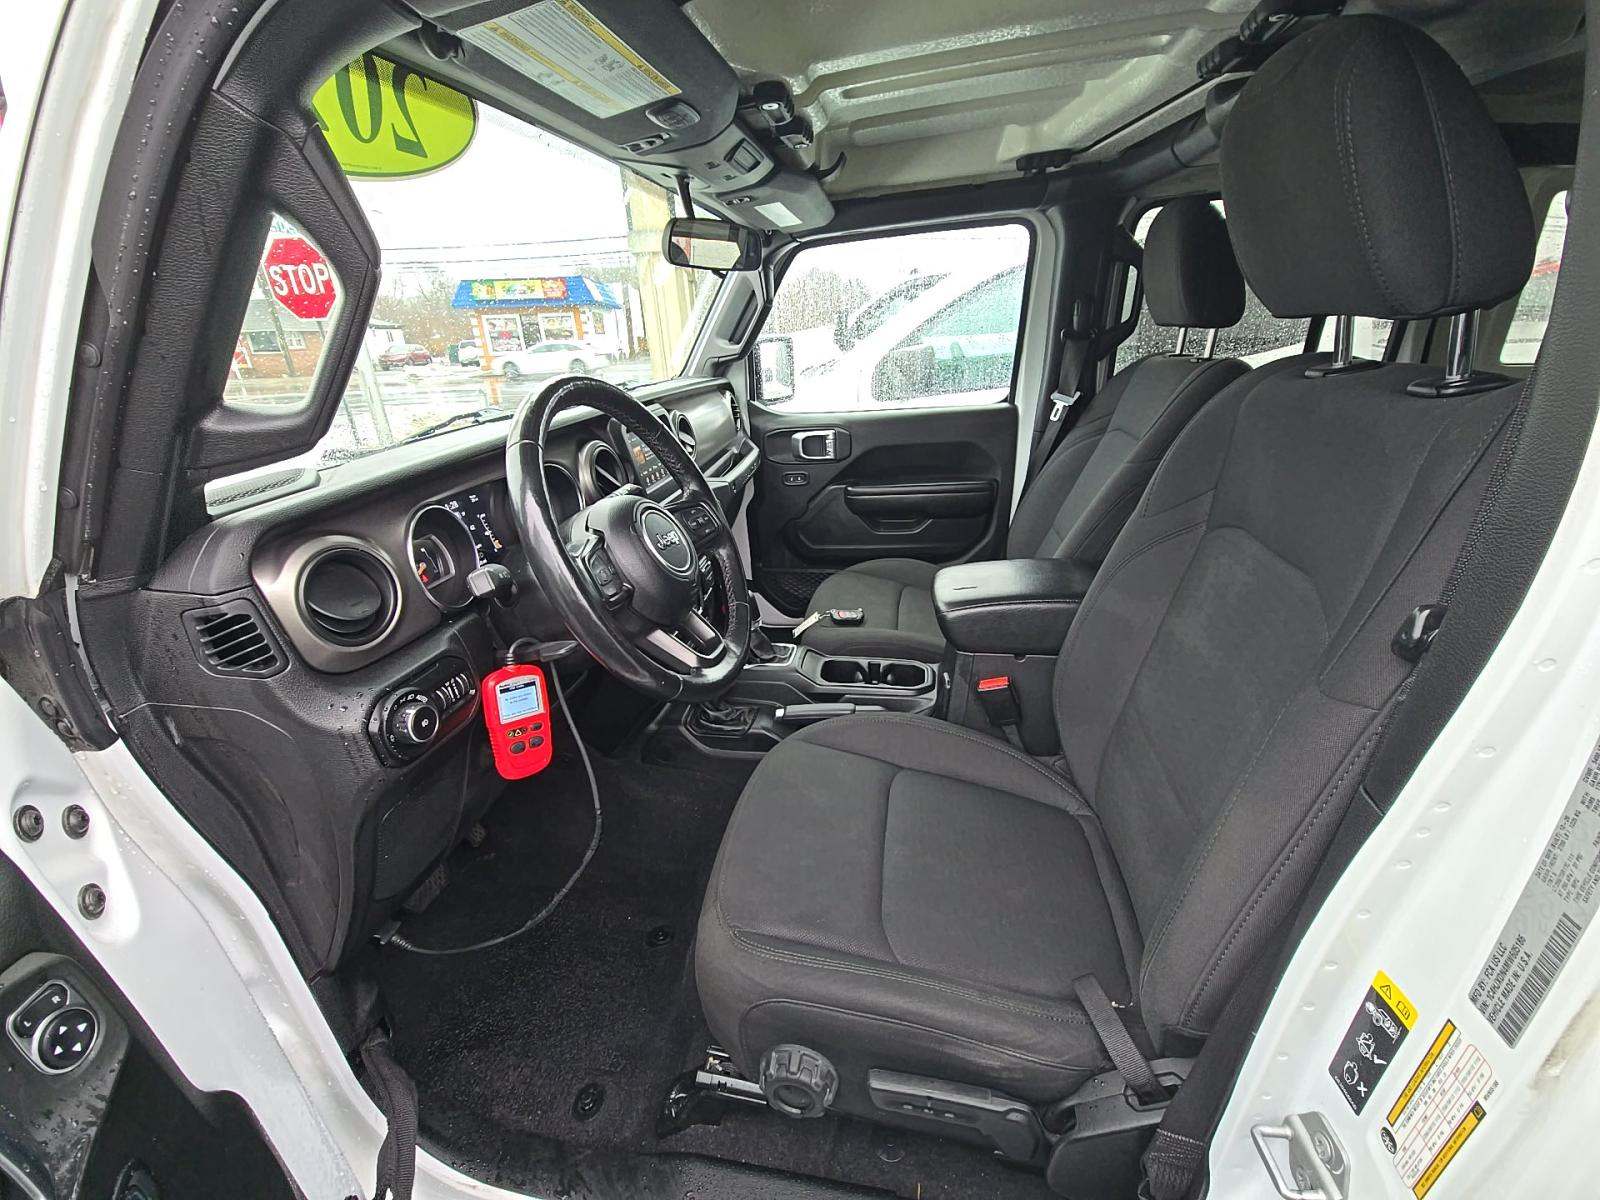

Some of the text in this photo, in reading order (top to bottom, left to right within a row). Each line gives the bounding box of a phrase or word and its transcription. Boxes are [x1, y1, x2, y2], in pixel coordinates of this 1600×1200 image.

[269, 262, 329, 296] STOP
[656, 530, 681, 551] Jeep
[1485, 965, 1495, 980] FCA
[1491, 954, 1501, 967] US
[1497, 942, 1507, 958] LLC
[51, 994, 61, 1004] R
[1488, 997, 1505, 1024] VEHICLE
[1501, 979, 1516, 1000] MADE
[23, 1020, 32, 1028] L
